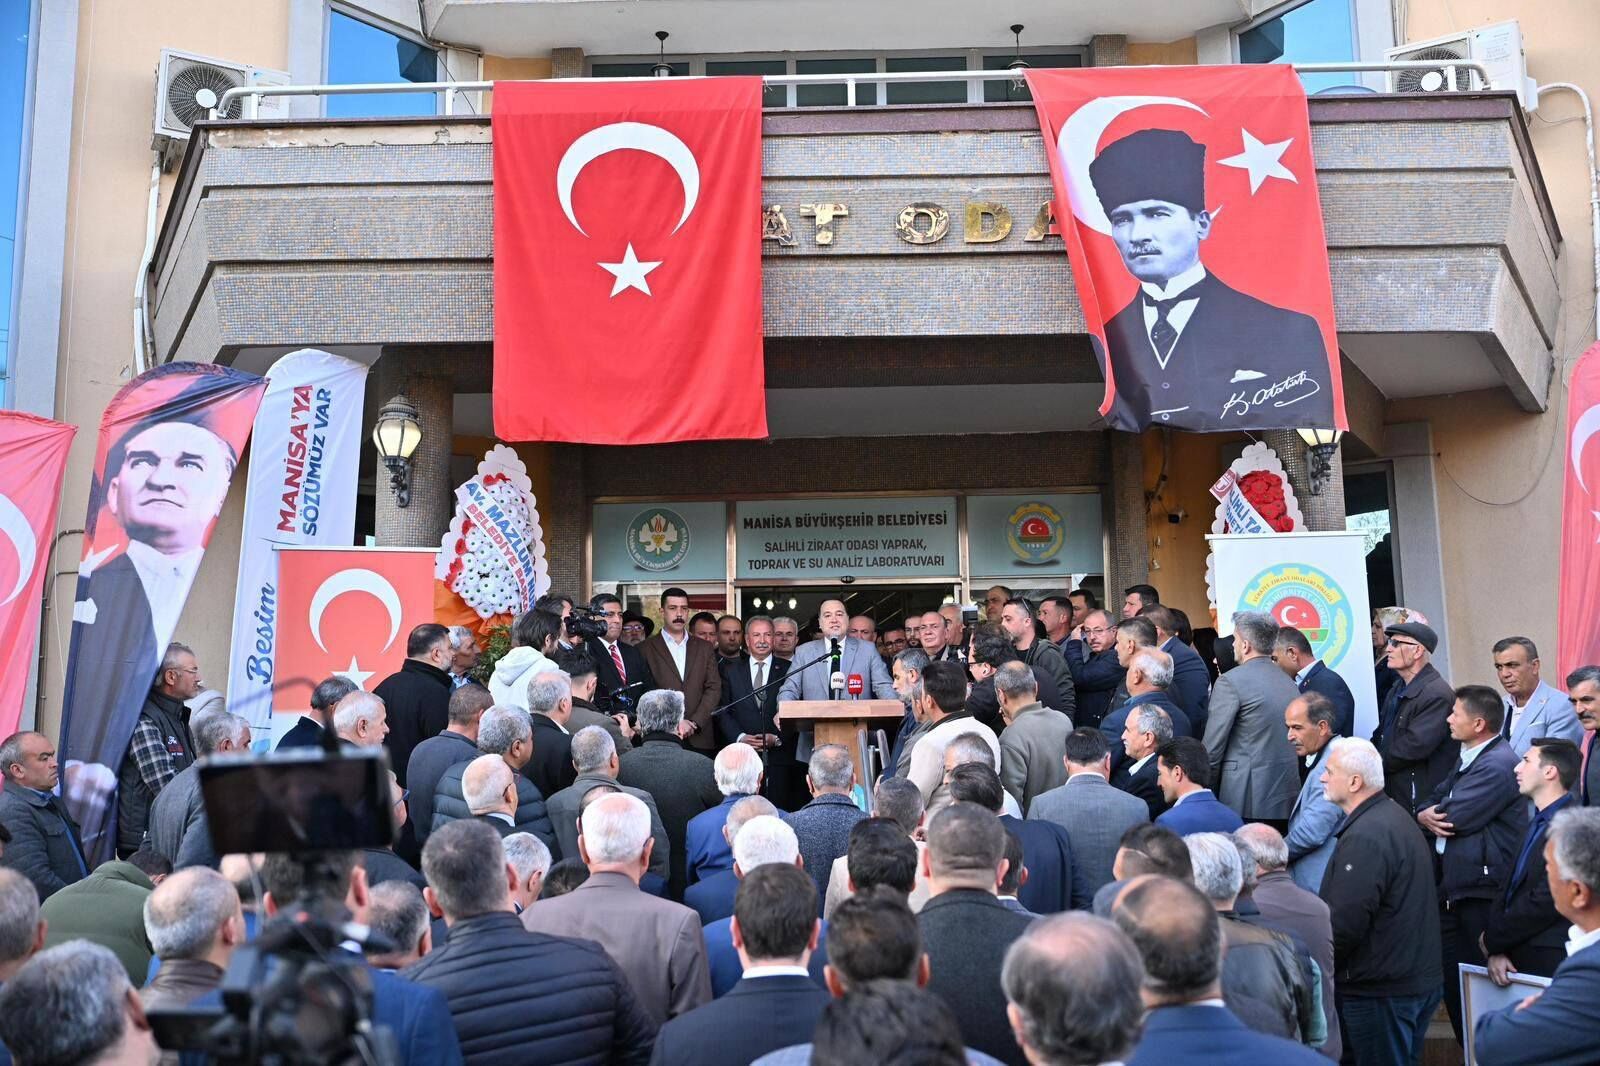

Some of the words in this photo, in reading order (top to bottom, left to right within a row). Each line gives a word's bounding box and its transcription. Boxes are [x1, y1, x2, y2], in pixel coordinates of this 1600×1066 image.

[762, 203, 849, 245] AT
[895, 201, 1065, 245] ODA
[276, 384, 314, 533] MANİSA'YA
[299, 434, 326, 536] SÖZÜMÜZ
[315, 387, 332, 426] VAR
[467, 503, 518, 568] BELEDİYE
[515, 568, 528, 612] BAŞKA
[486, 504, 533, 577] MAZLUM
[528, 577, 536, 609] HUR
[743, 513, 792, 530] MANİSA
[795, 511, 874, 530] BÜYÜKŞEHİR
[877, 510, 948, 527] BELEDİYESİ
[748, 558, 790, 570] TOPRAK
[792, 558, 806, 569] VE
[808, 557, 823, 568] SU
[826, 555, 864, 568] ANALİZ
[866, 555, 945, 567] LABORATUVARI
[764, 539, 805, 553] SALİHLİ
[807, 538, 844, 551] ZİRAAT
[847, 539, 879, 551] ODASI
[881, 537, 927, 551] YAPRAK,
[246, 582, 276, 685] Besim
